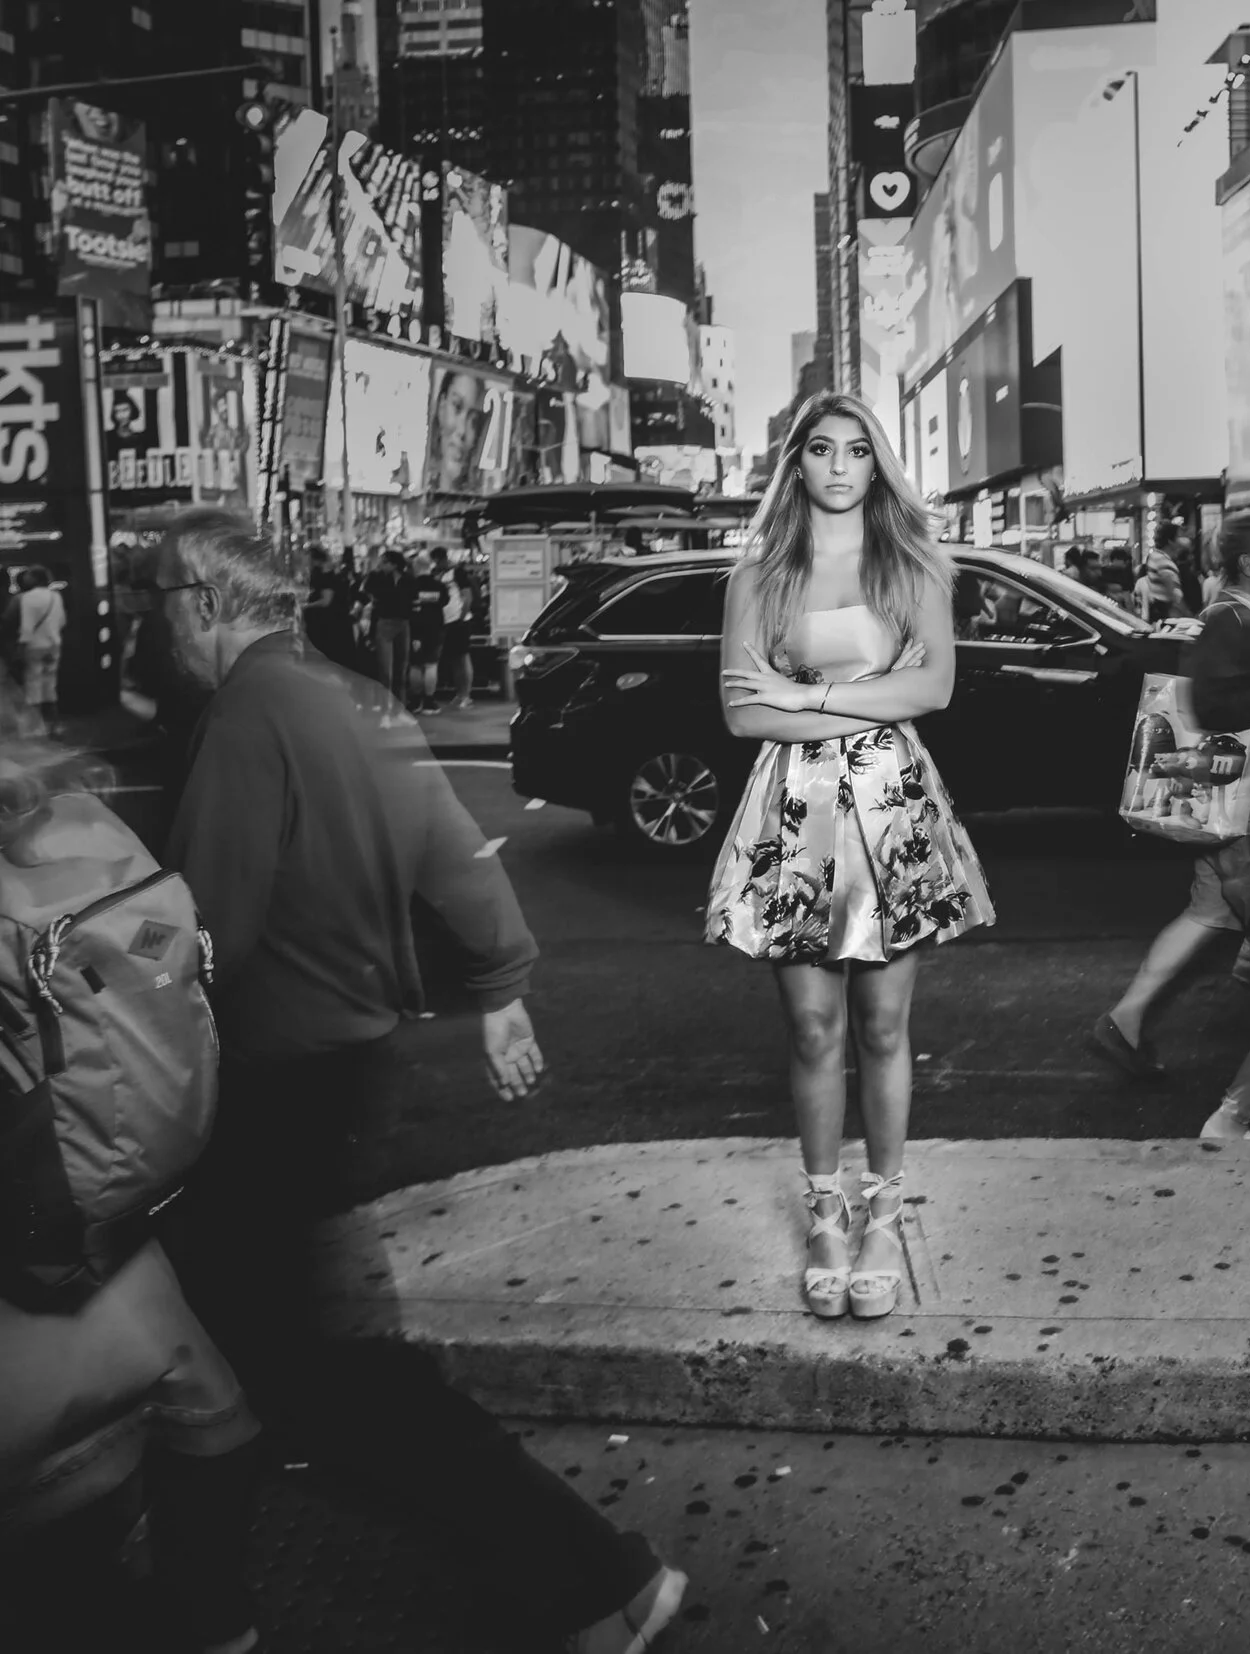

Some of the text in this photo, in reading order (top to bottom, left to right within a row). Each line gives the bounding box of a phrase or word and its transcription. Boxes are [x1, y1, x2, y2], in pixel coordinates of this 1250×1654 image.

[63, 224, 149, 264] Tootsie
[0, 314, 61, 484] tkts
[478, 387, 515, 472] 21
[1209, 754, 1234, 776] m
